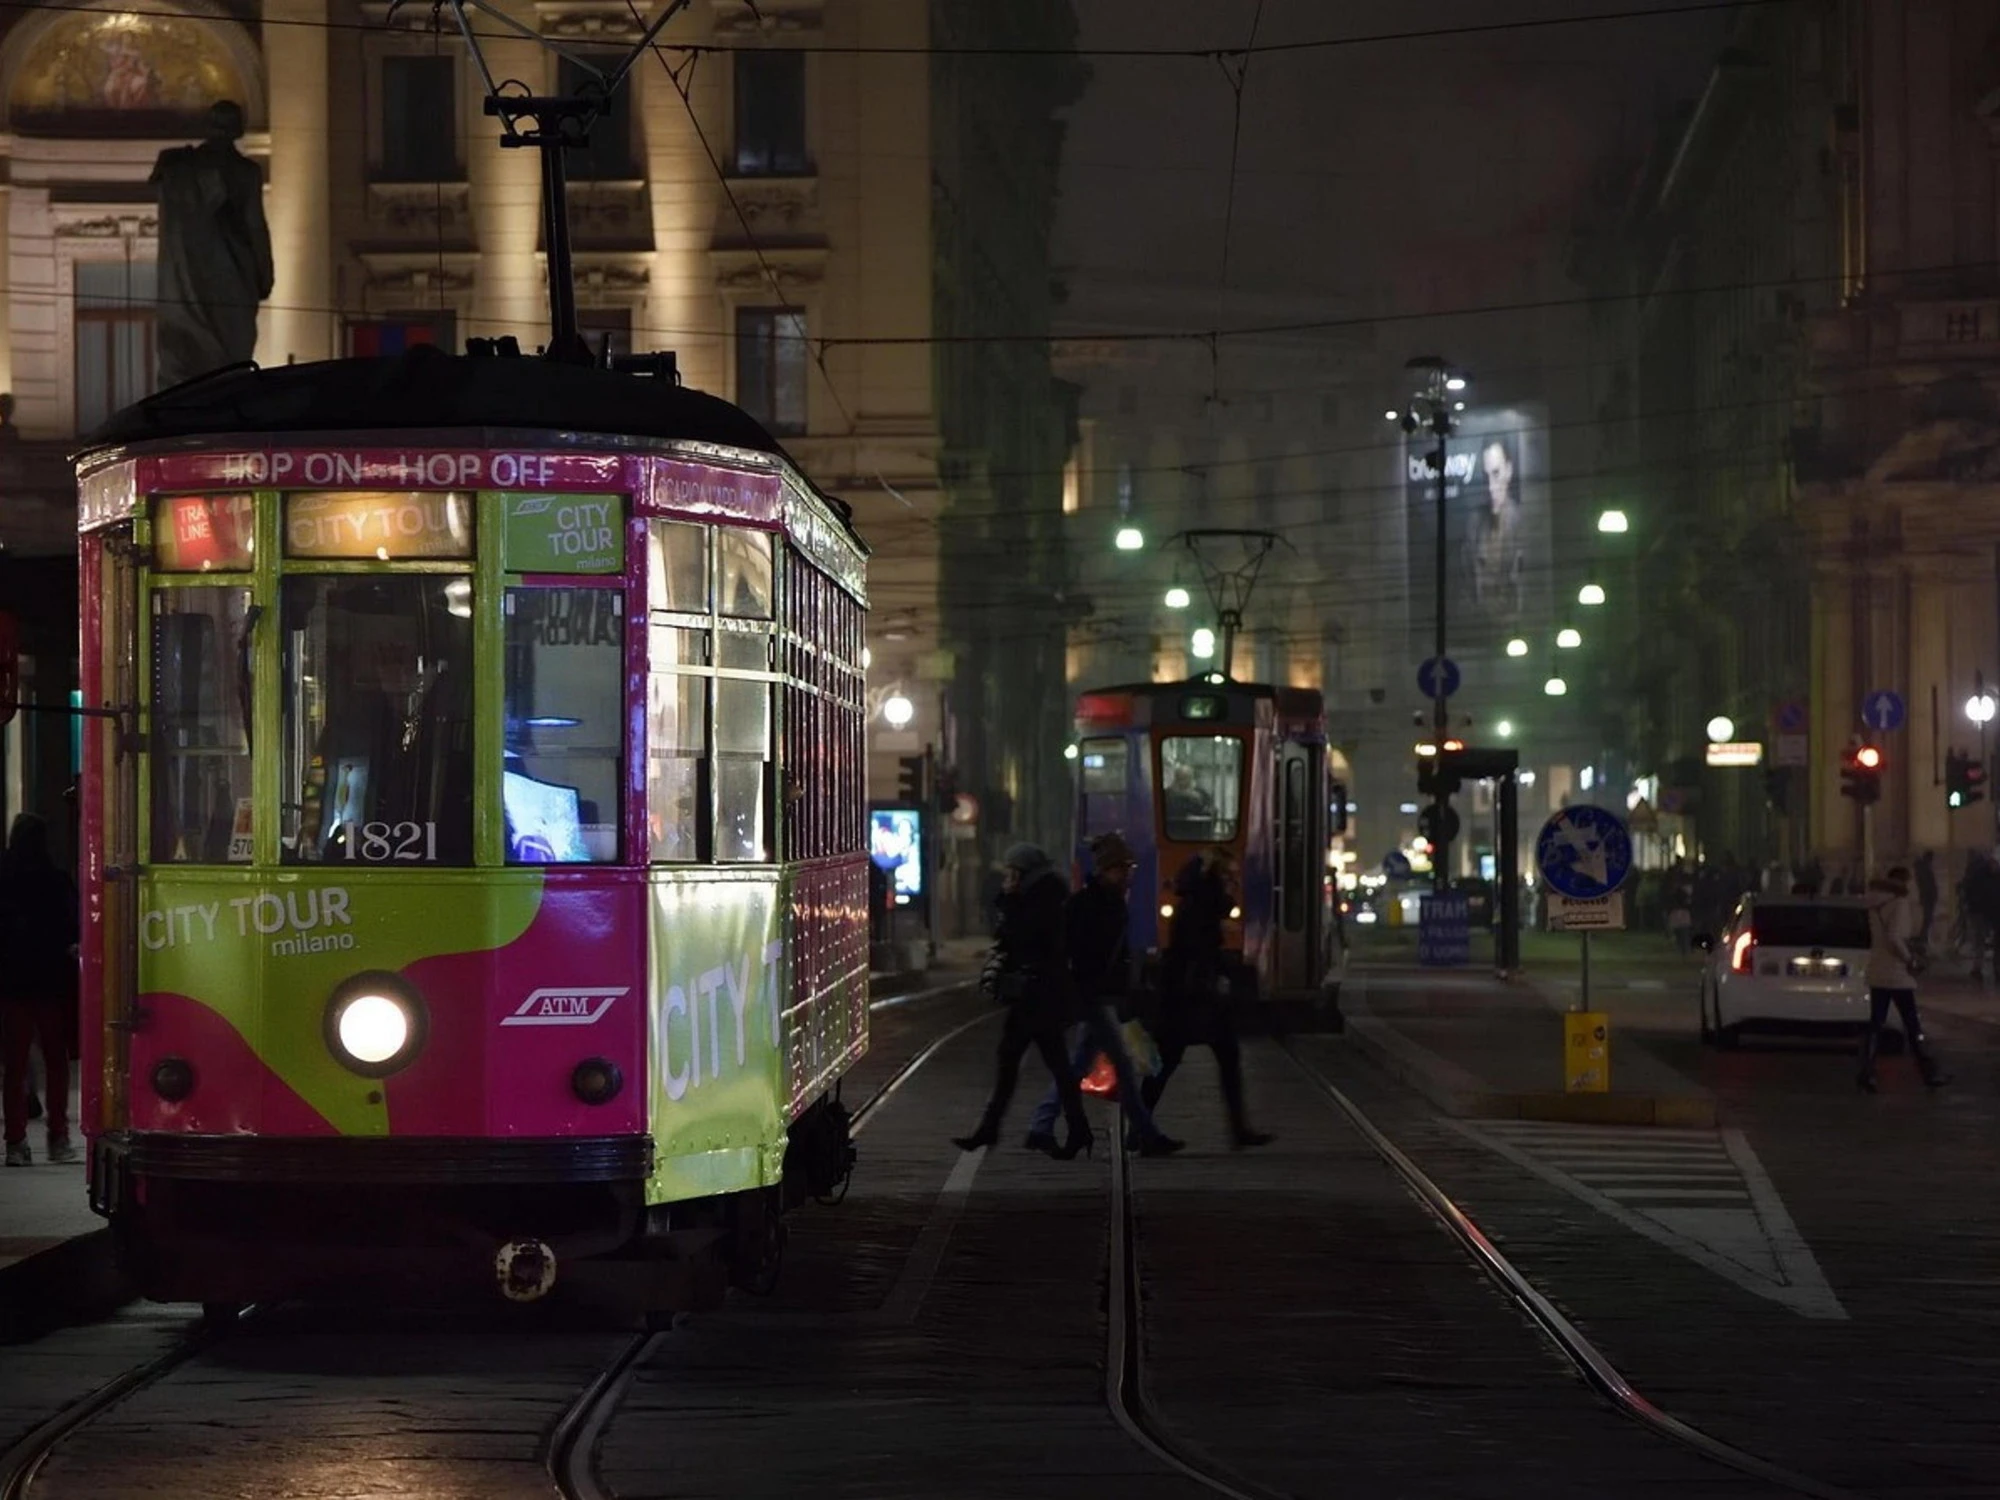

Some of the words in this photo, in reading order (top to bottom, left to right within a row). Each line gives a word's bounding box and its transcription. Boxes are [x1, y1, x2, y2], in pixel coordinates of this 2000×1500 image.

[224, 452, 293, 484] HOP
[304, 453, 362, 485] ON
[400, 453, 482, 486] HOP
[490, 453, 556, 487] OFF
[180, 521, 212, 542] LINE
[292, 511, 368, 549] CITY
[556, 503, 609, 531] CITY
[547, 527, 613, 556] TOUR
[343, 820, 437, 862] 1821
[141, 902, 220, 950] CITY
[230, 886, 353, 937] TOUR
[271, 931, 355, 957] milano
[538, 996, 590, 1016] ATM
[660, 951, 750, 1101] CITY
